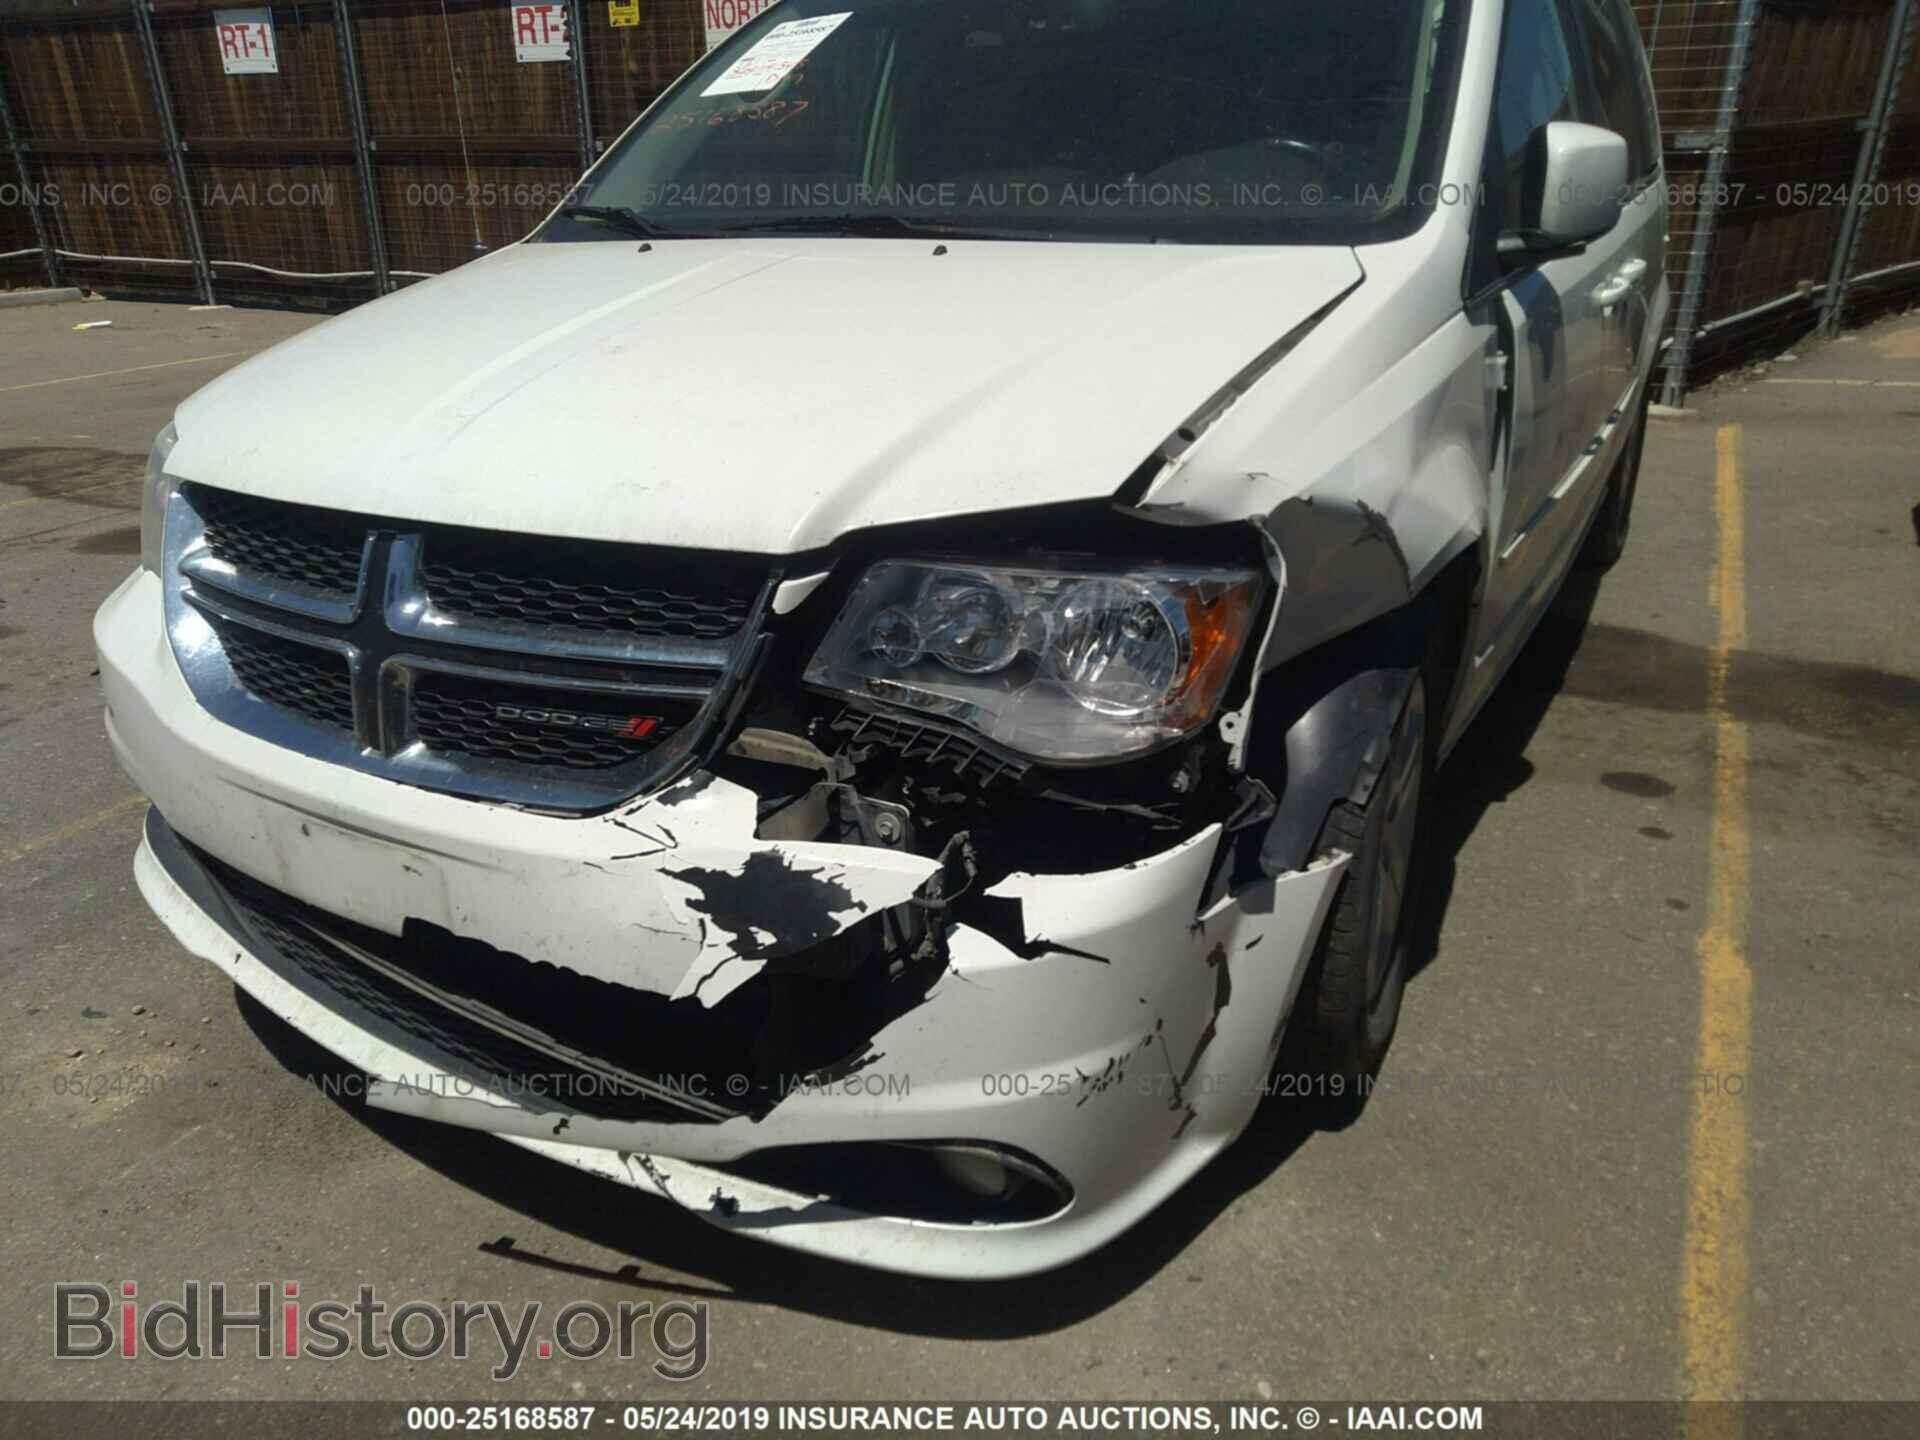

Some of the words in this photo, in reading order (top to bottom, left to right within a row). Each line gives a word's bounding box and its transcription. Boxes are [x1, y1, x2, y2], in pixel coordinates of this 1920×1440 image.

[704, 0, 769, 29] NORT
[220, 24, 270, 59] RT-1
[496, 706, 634, 732] DODGE
